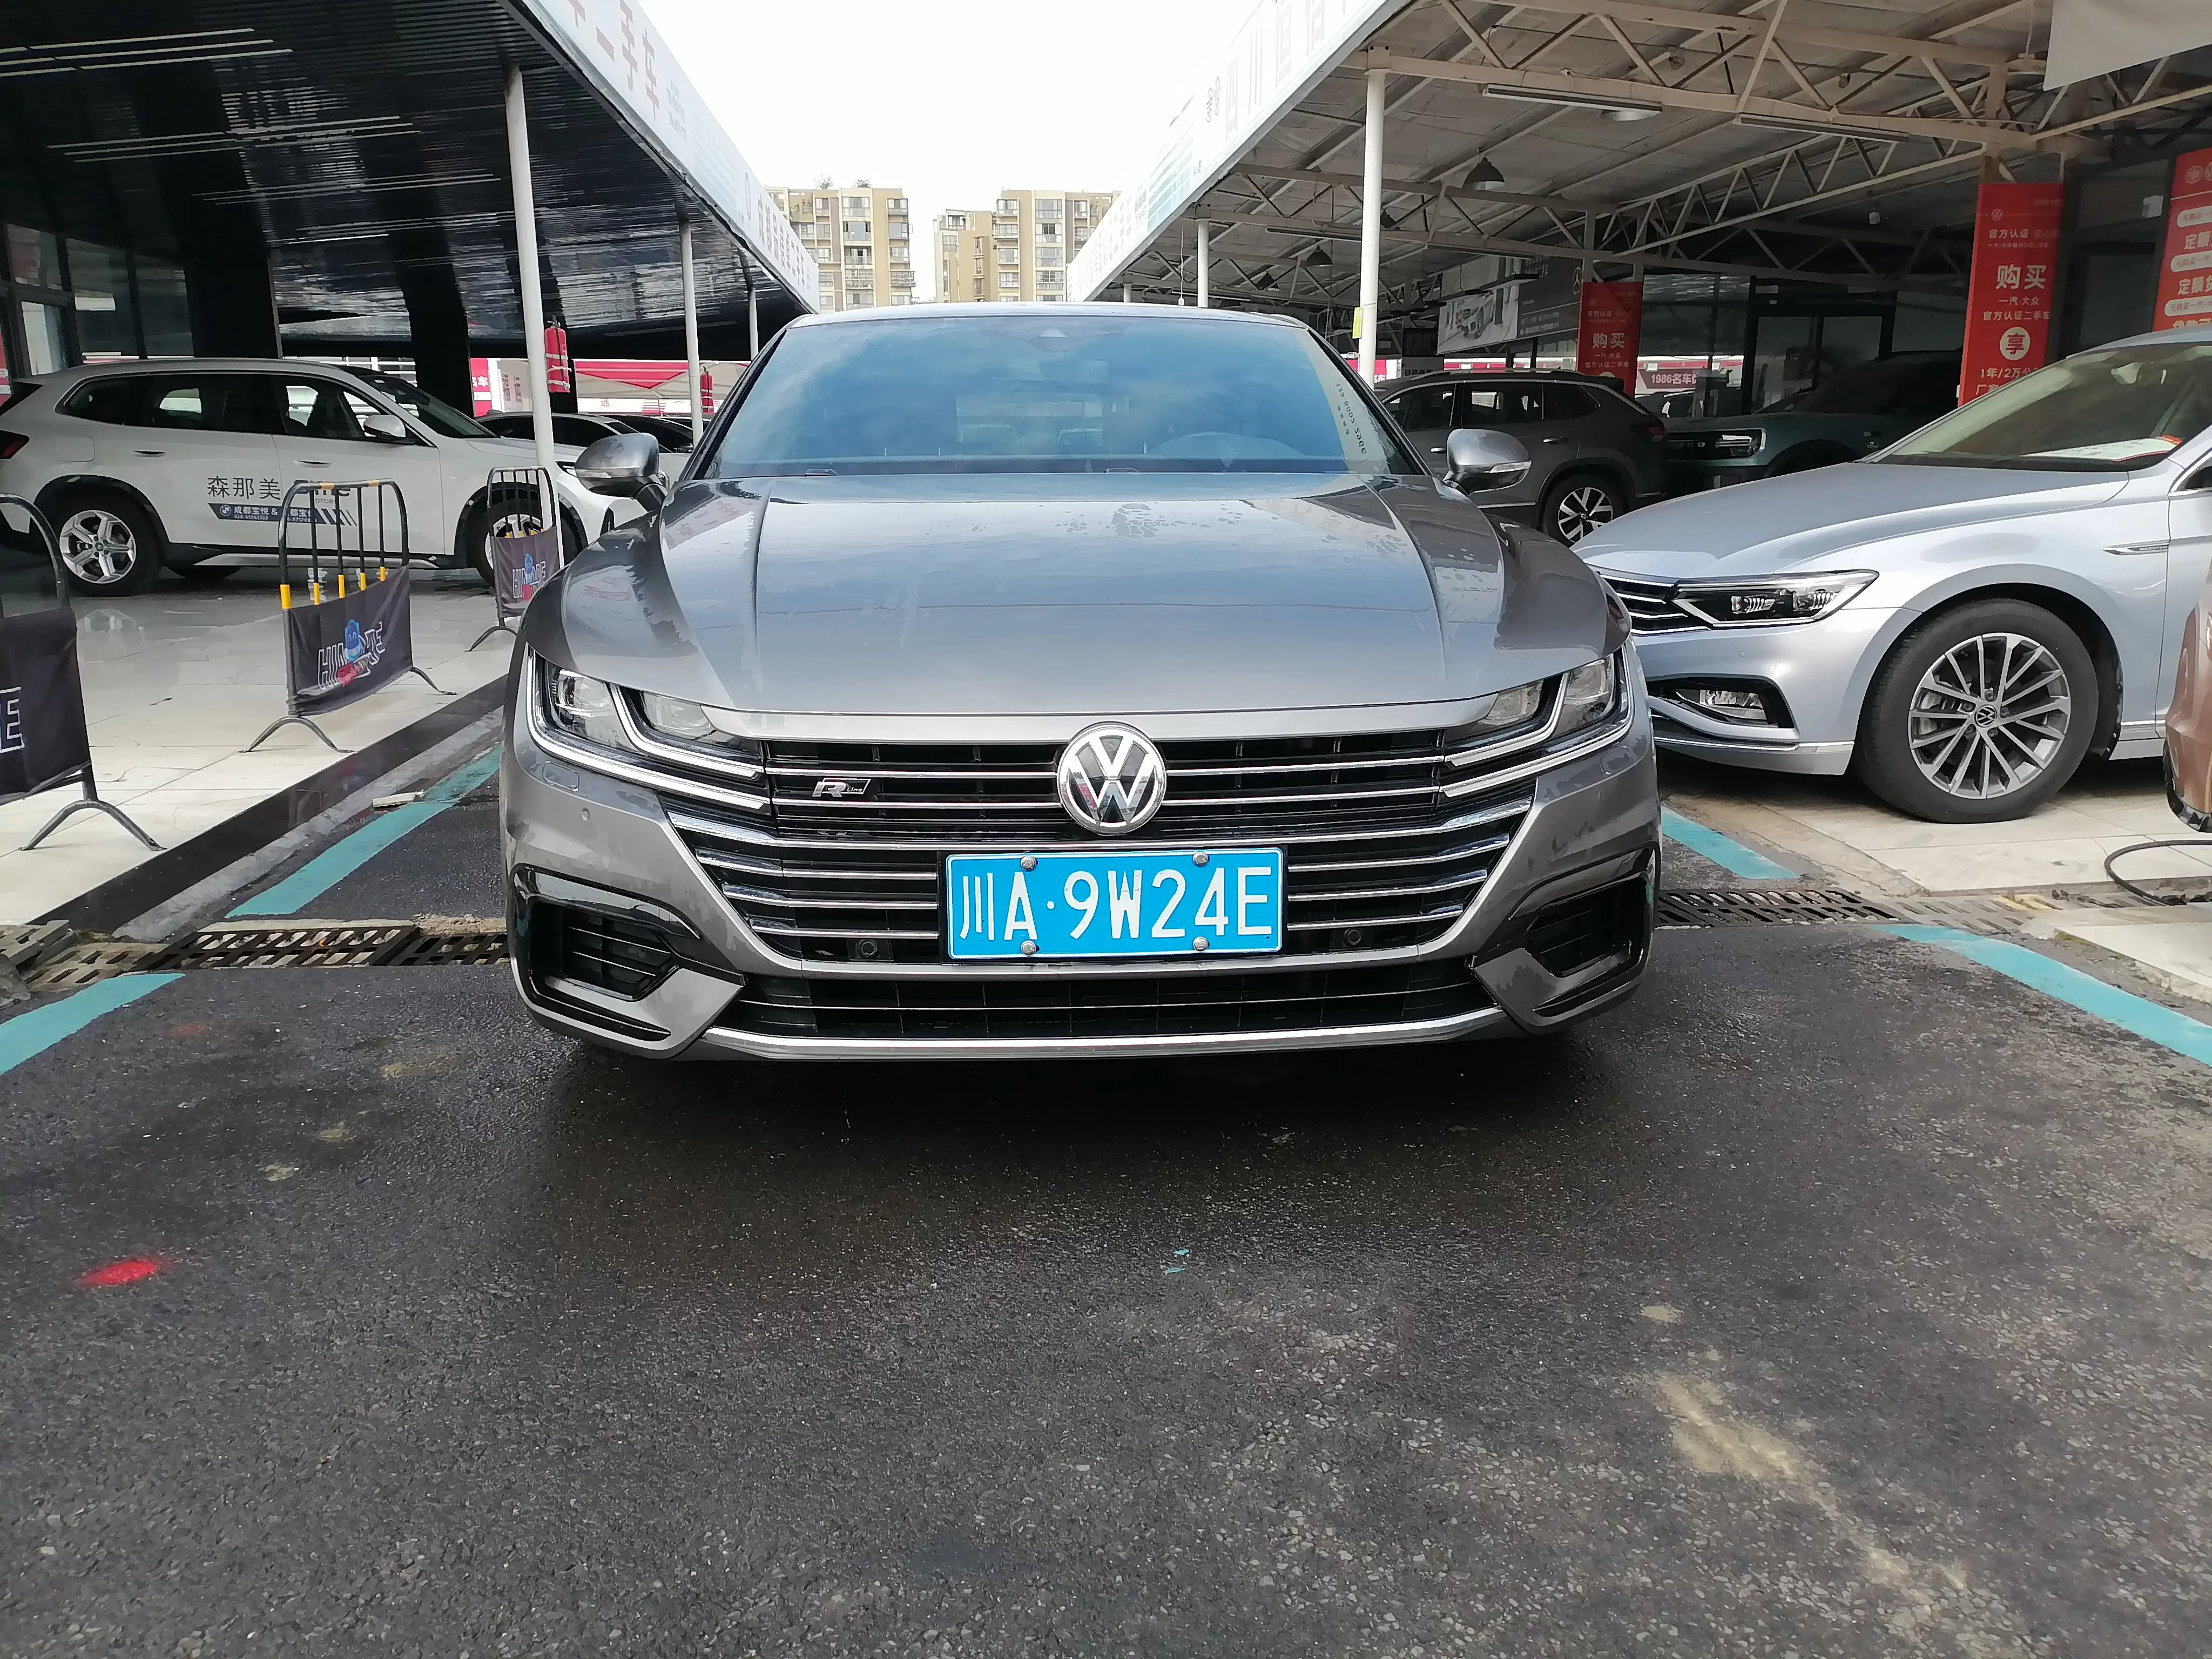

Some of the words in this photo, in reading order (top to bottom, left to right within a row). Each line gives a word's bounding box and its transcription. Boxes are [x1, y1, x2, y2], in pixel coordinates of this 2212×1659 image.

[1995, 264, 2047, 289] 购买
[1984, 311, 2051, 321] 官方认证二手车
[1593, 333, 1625, 348] 购买
[2005, 333, 2025, 355] 享
[207, 475, 281, 500] 森那美
[234, 505, 269, 515] 成都宝悦
[960, 865, 1272, 941] 川A·9W24E
